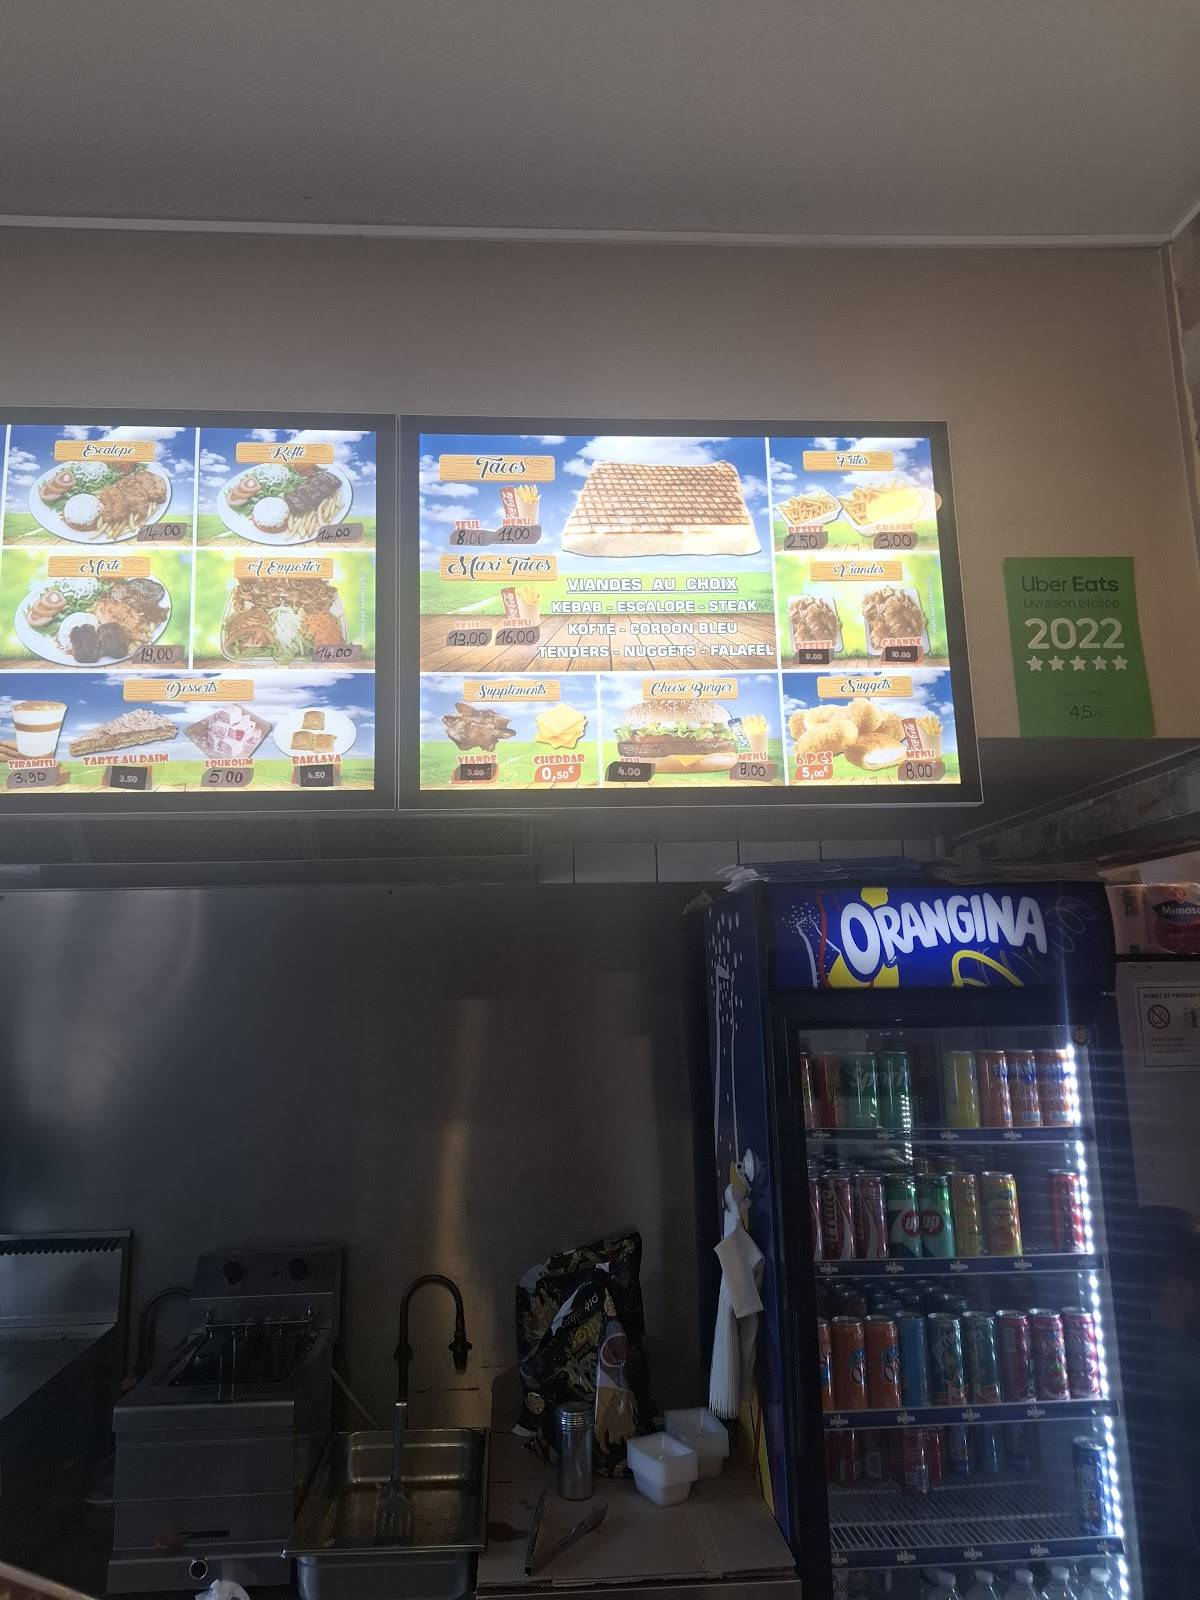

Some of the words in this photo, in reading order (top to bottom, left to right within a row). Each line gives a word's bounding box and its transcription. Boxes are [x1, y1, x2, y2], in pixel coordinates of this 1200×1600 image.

[83, 443, 135, 459] Escalope
[476, 456, 528, 478] Tacos
[502, 517, 530, 526] MENU
[269, 560, 321, 575] Emporter
[447, 555, 501, 579] Maxi
[507, 556, 552, 576] Tacos
[567, 578, 643, 591] VIANDES
[652, 578, 676, 590] AU
[685, 577, 738, 590] CHOIX
[1021, 576, 1068, 593] Uber
[1072, 576, 1120, 593] Eats
[552, 601, 602, 613] KEBAB
[617, 601, 695, 612] ESCALOPE
[708, 600, 758, 612] STEAK
[1023, 599, 1076, 609] Livraison
[502, 618, 532, 627] MENU
[567, 623, 616, 635] KOFTE
[630, 623, 695, 635] CORDON
[699, 622, 738, 634] BLEU
[1024, 617, 1126, 650] 2022
[538, 646, 610, 658] TENDERS
[624, 645, 696, 657] NUGGETS
[710, 644, 774, 656] FALAFEL
[166, 681, 218, 698] Desserts
[651, 681, 688, 696] Cheese
[690, 680, 732, 697] Burger
[840, 678, 892, 694] Nuggets
[83, 756, 119, 766] TARTE
[121, 756, 137, 765] AU
[138, 754, 168, 764] DAIM
[292, 754, 341, 764] BAKLAVA
[534, 754, 586, 765] CHEDDAR
[737, 752, 767, 761] MENU
[905, 750, 935, 759] MENU
[8, 759, 57, 768] TIRAMISU
[205, 758, 254, 768] LOUKOUM
[839, 892, 1048, 977] ORANGINA
